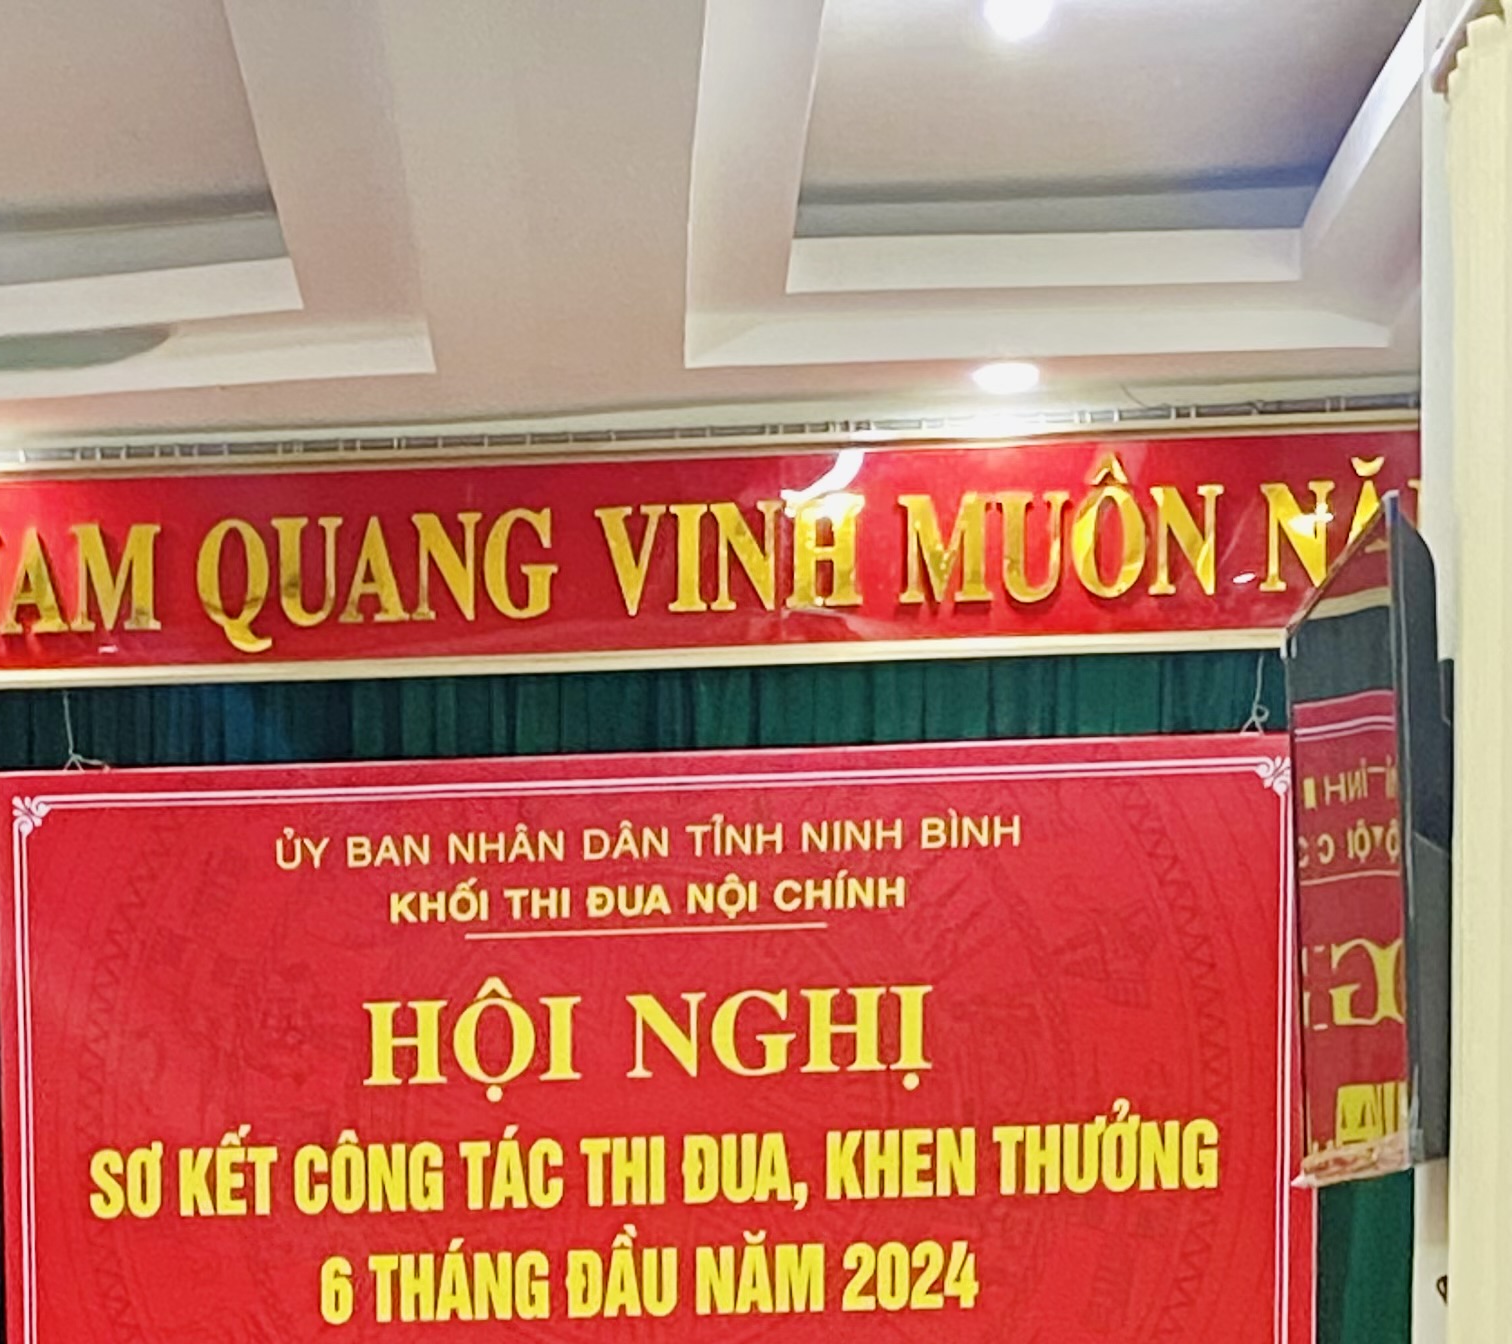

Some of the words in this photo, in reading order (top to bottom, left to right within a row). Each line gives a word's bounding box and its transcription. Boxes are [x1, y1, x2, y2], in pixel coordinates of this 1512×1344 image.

[196, 507, 558, 653] QUANG
[595, 493, 864, 616] VINH
[897, 452, 1224, 604] MUÔN
[275, 824, 330, 871] ỦY
[347, 834, 431, 868] BAN
[448, 822, 566, 864] NHÂN
[583, 820, 671, 861] DÂN
[687, 812, 784, 859] TỈNH
[802, 815, 904, 855] NINH
[921, 808, 1022, 851] BÌNH
[390, 880, 489, 924] KHỐI
[505, 888, 572, 921] THI
[586, 883, 670, 918] ĐUA
[687, 873, 758, 921] NỘI
[773, 874, 908, 913] CHÍNH
[362, 977, 582, 1101] HỘI
[626, 984, 933, 1090] NGHỊ
[89, 1140, 163, 1219] SƠ
[179, 1123, 278, 1216] KẾT
[293, 1128, 444, 1214] CÔNG
[459, 1125, 564, 1210] TÁC
[580, 1135, 666, 1206] THI
[681, 1132, 809, 1211] ĐUA,
[825, 1127, 977, 1199] KHEN
[993, 1098, 1219, 1195] THƯỞNG
[320, 1256, 353, 1325] 6
[368, 1238, 550, 1323] THÁNG
[565, 1223, 678, 1318] ĐẦU
[695, 1229, 825, 1315] NĂM
[842, 1240, 980, 1312] 2024
